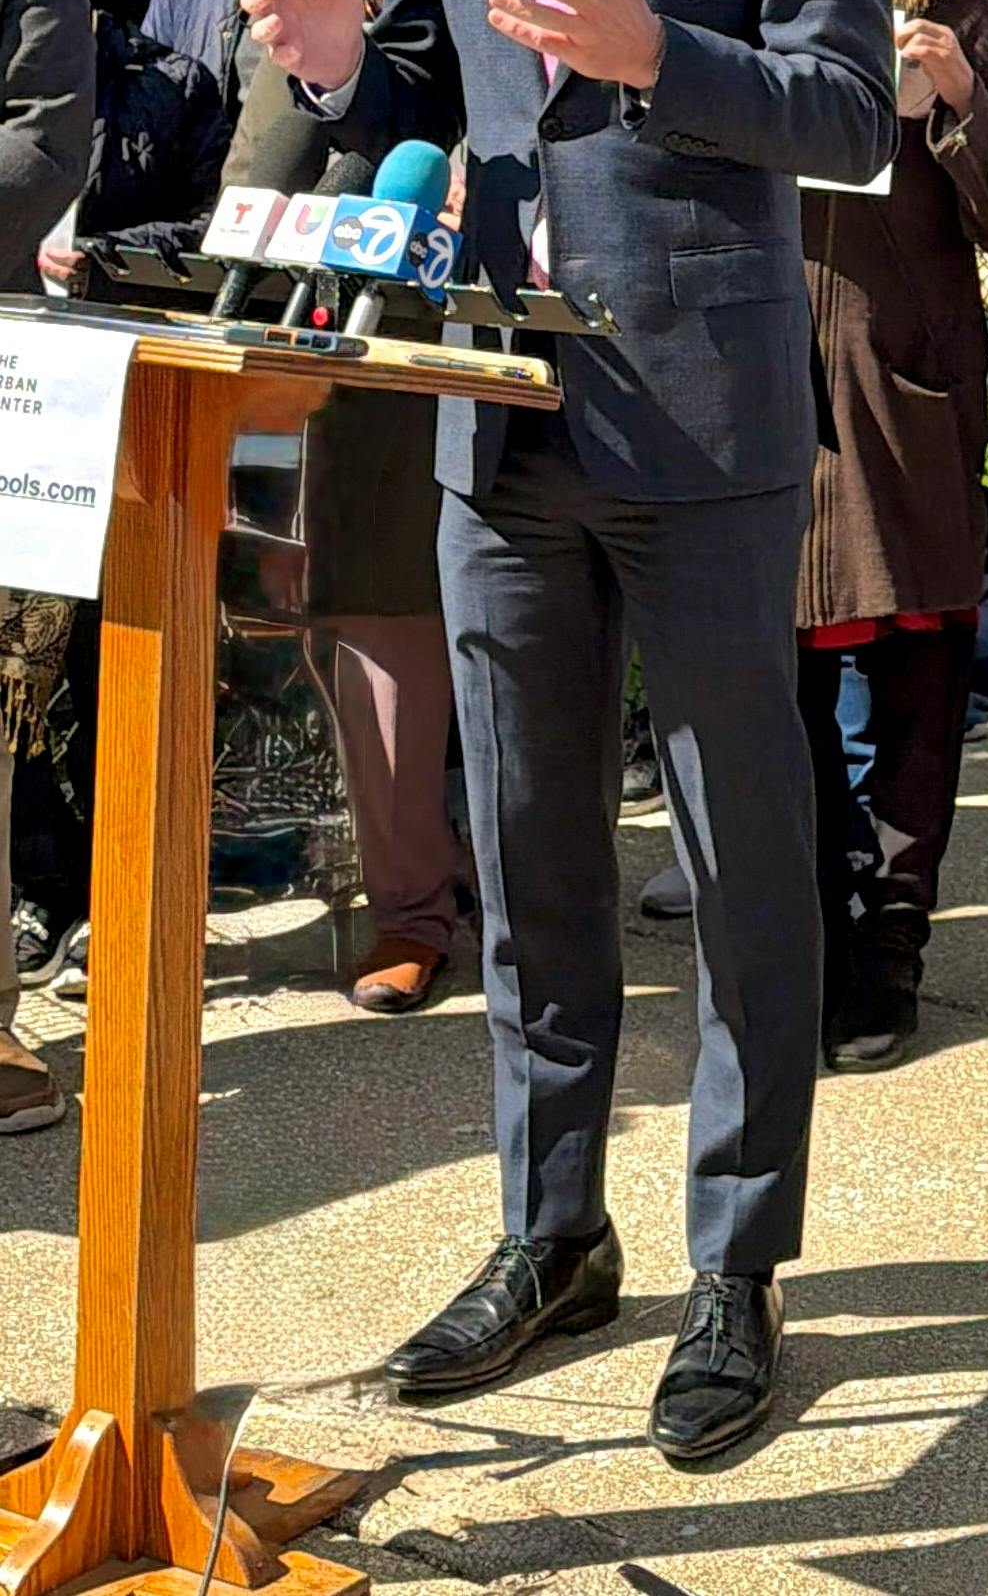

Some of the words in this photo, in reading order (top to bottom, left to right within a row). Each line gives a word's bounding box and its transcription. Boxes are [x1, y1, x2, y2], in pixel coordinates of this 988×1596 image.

[333, 223, 363, 241] abc
[0, 354, 19, 370] HE
[0, 395, 43, 415] NTER
[0, 472, 96, 504] ools.com
